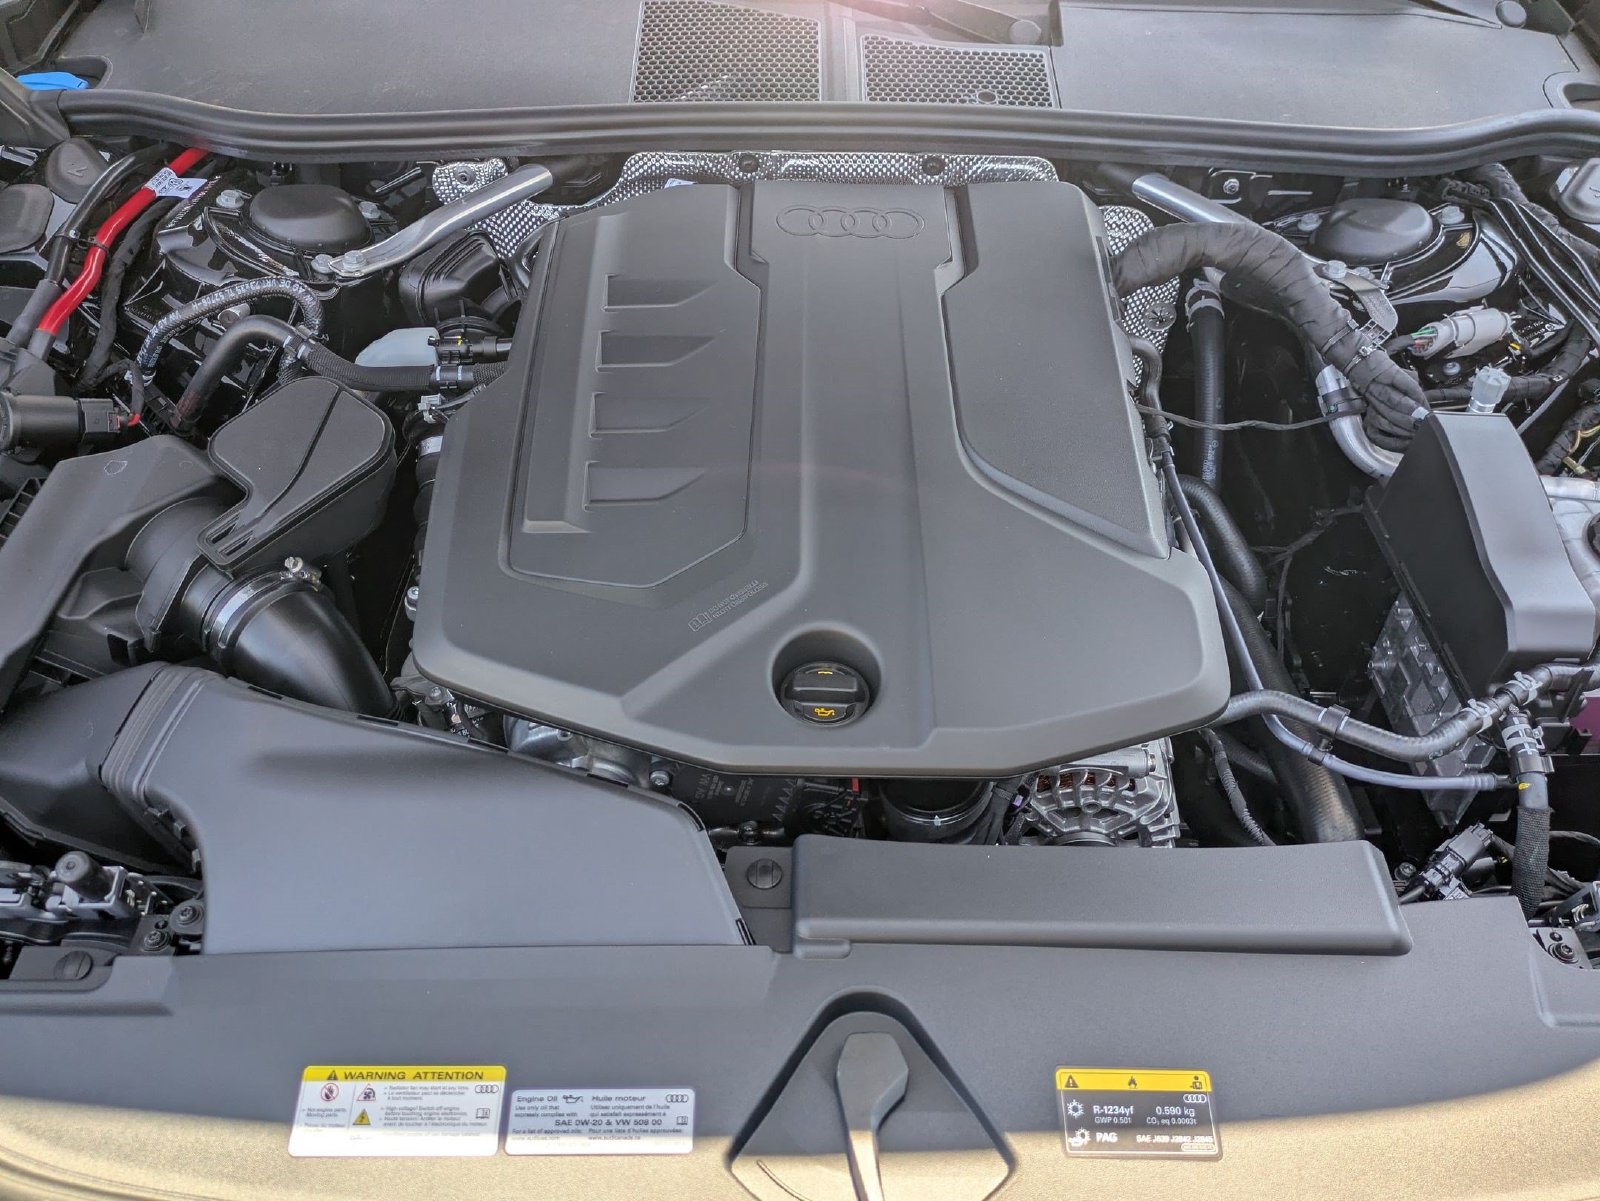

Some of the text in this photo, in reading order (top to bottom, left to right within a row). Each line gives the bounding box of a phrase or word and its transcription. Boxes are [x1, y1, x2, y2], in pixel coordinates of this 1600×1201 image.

[343, 1071, 485, 1080] WARNING ATTENTION
[1093, 1105, 1135, 1116] R-1234yf
[1155, 1106, 1196, 1117] 0.590 kg
[1096, 1132, 1118, 1143] PAG
[1136, 1135, 1151, 1143] SAE
